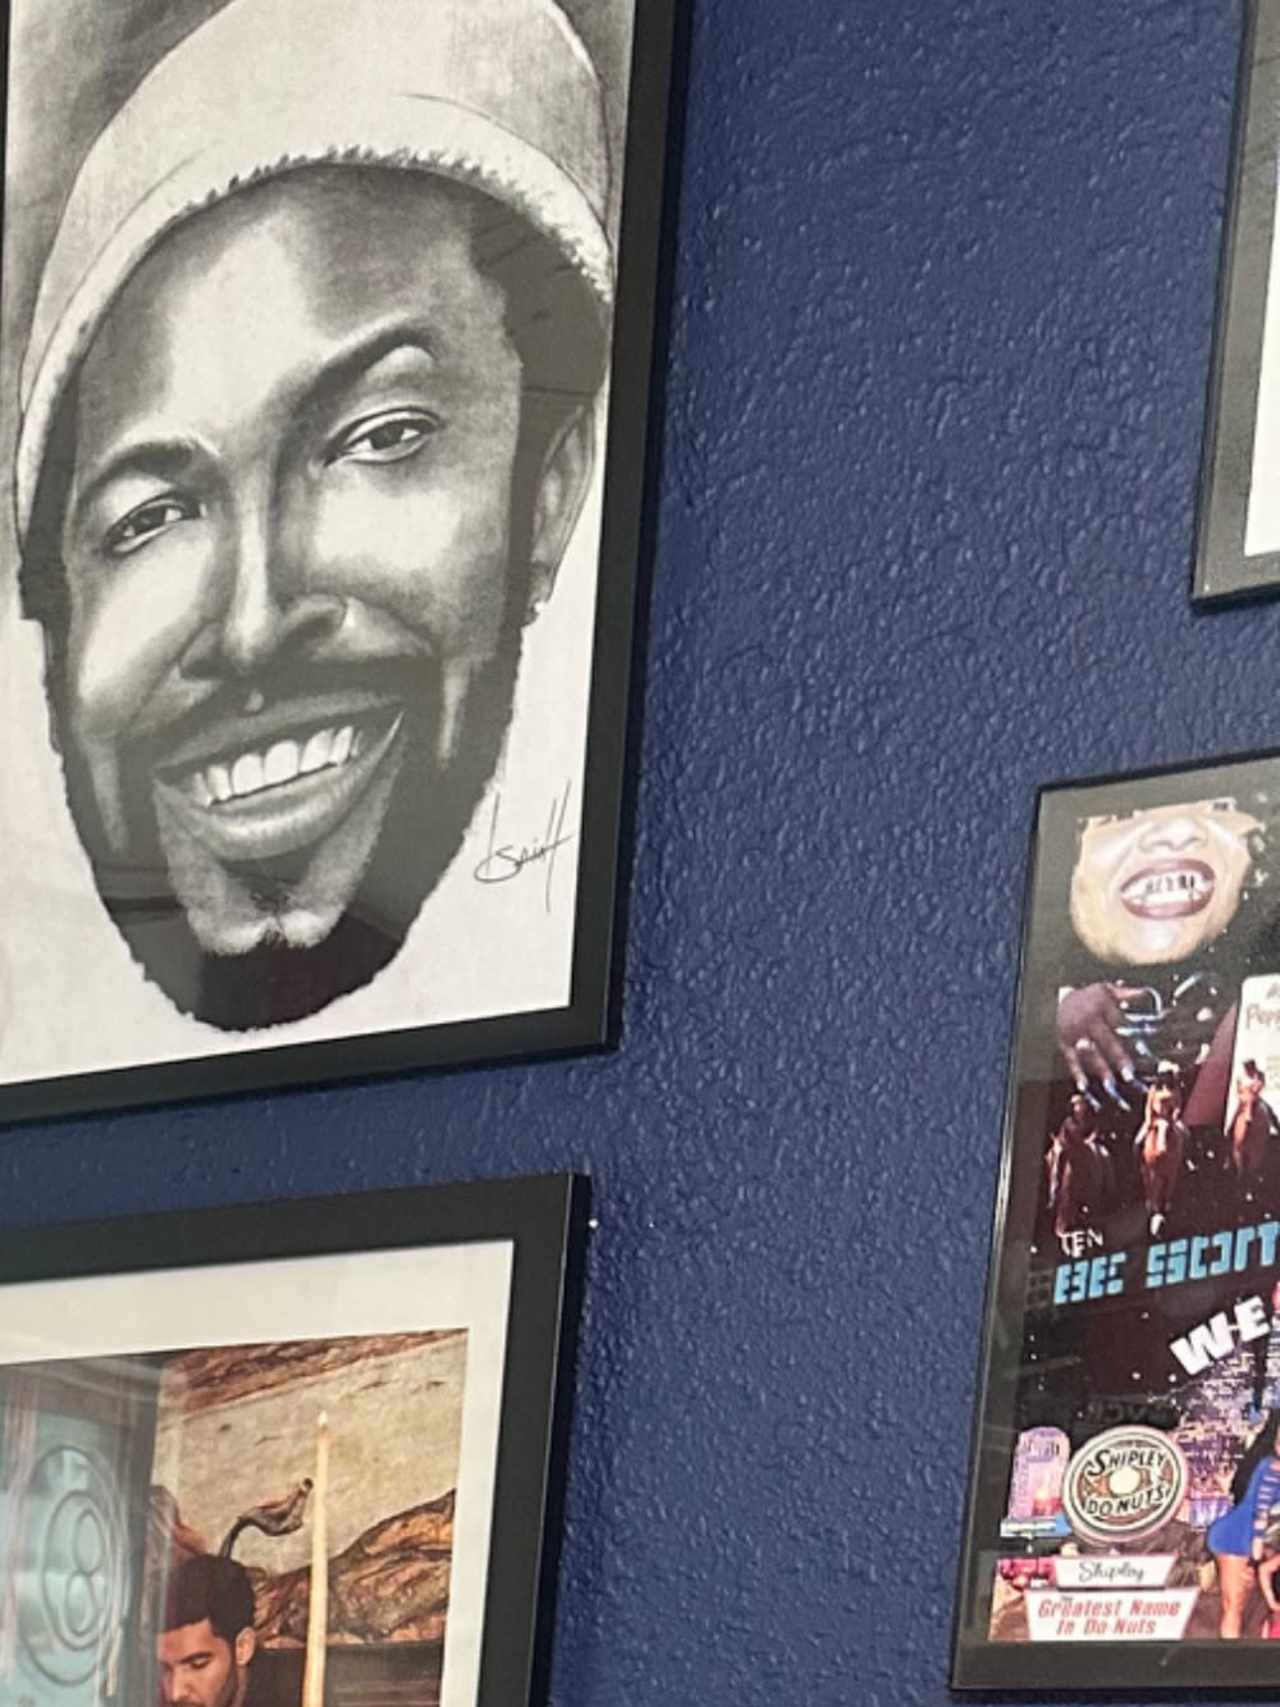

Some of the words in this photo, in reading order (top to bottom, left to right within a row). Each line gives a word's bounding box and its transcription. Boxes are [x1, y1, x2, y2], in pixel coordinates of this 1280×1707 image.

[1087, 1447, 1166, 1477] SHIPLEY
[1038, 1599, 1121, 1619] Greatest
[1131, 1599, 1182, 1617] Name
